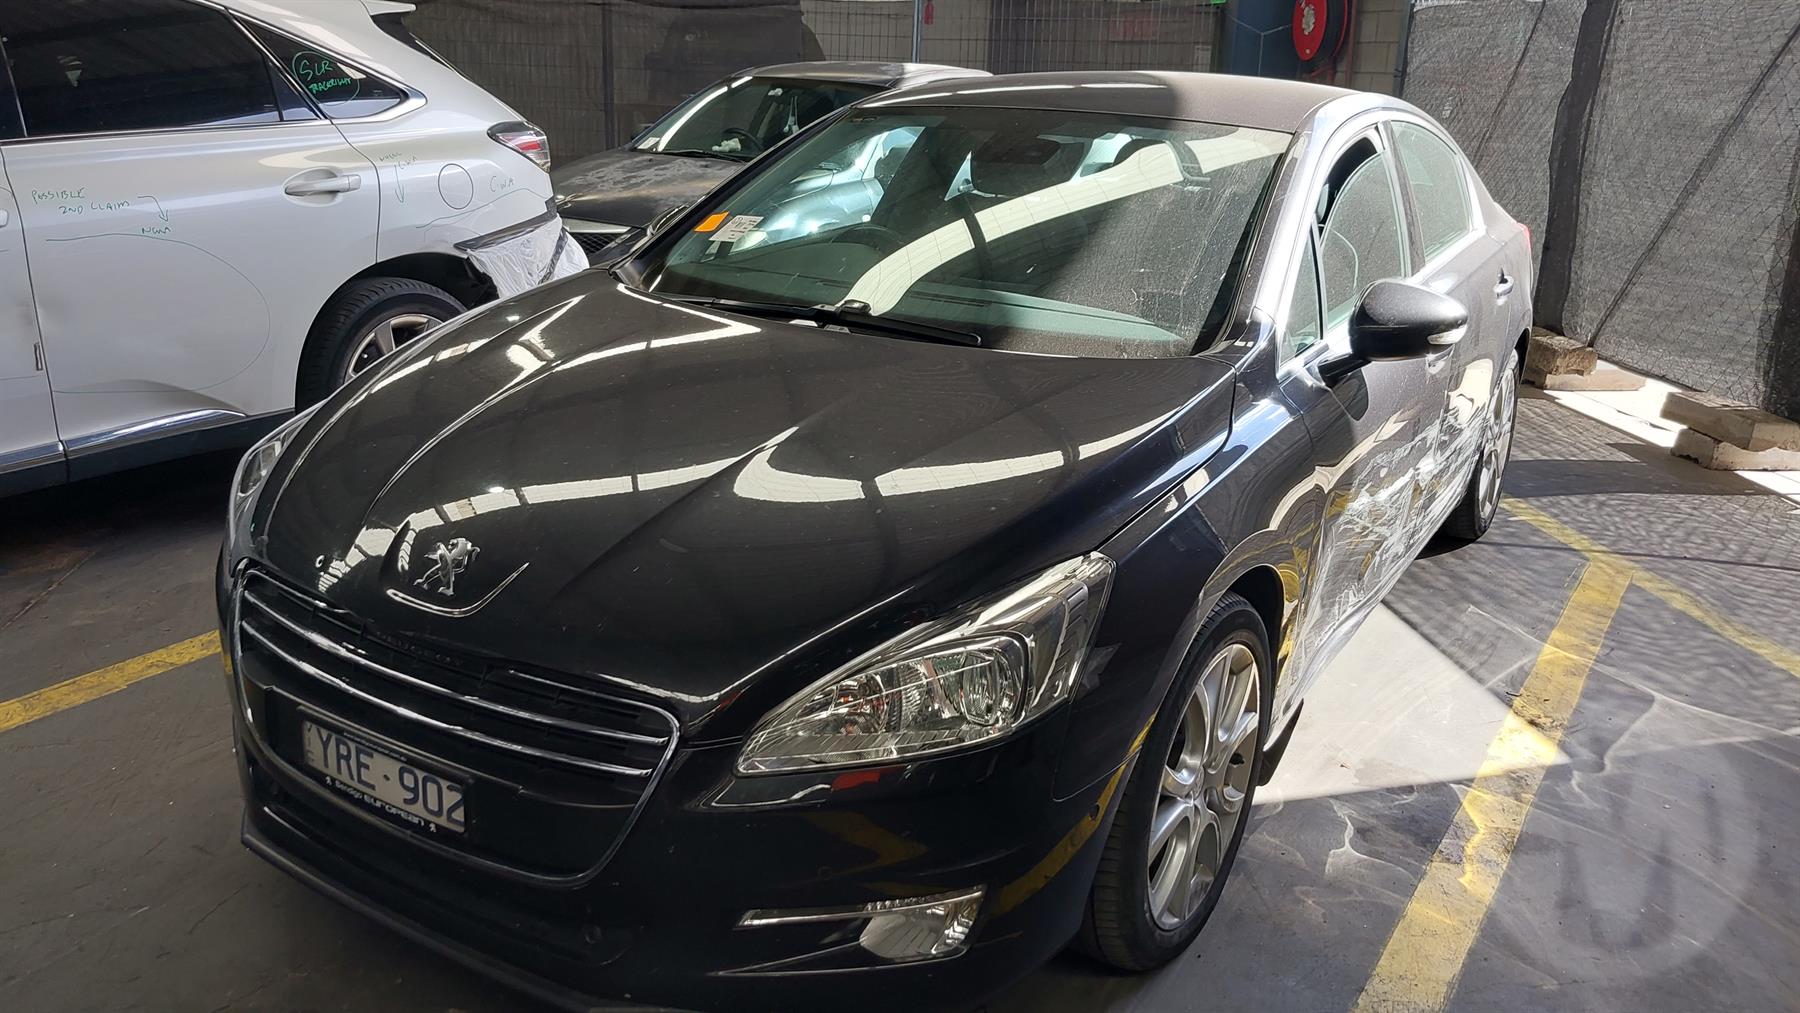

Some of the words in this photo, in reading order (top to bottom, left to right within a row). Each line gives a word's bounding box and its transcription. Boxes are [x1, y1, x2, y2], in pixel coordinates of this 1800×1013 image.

[31, 187, 86, 205] POSSIBLE
[58, 205, 84, 215] 2ND
[90, 200, 130, 212] CLAIM
